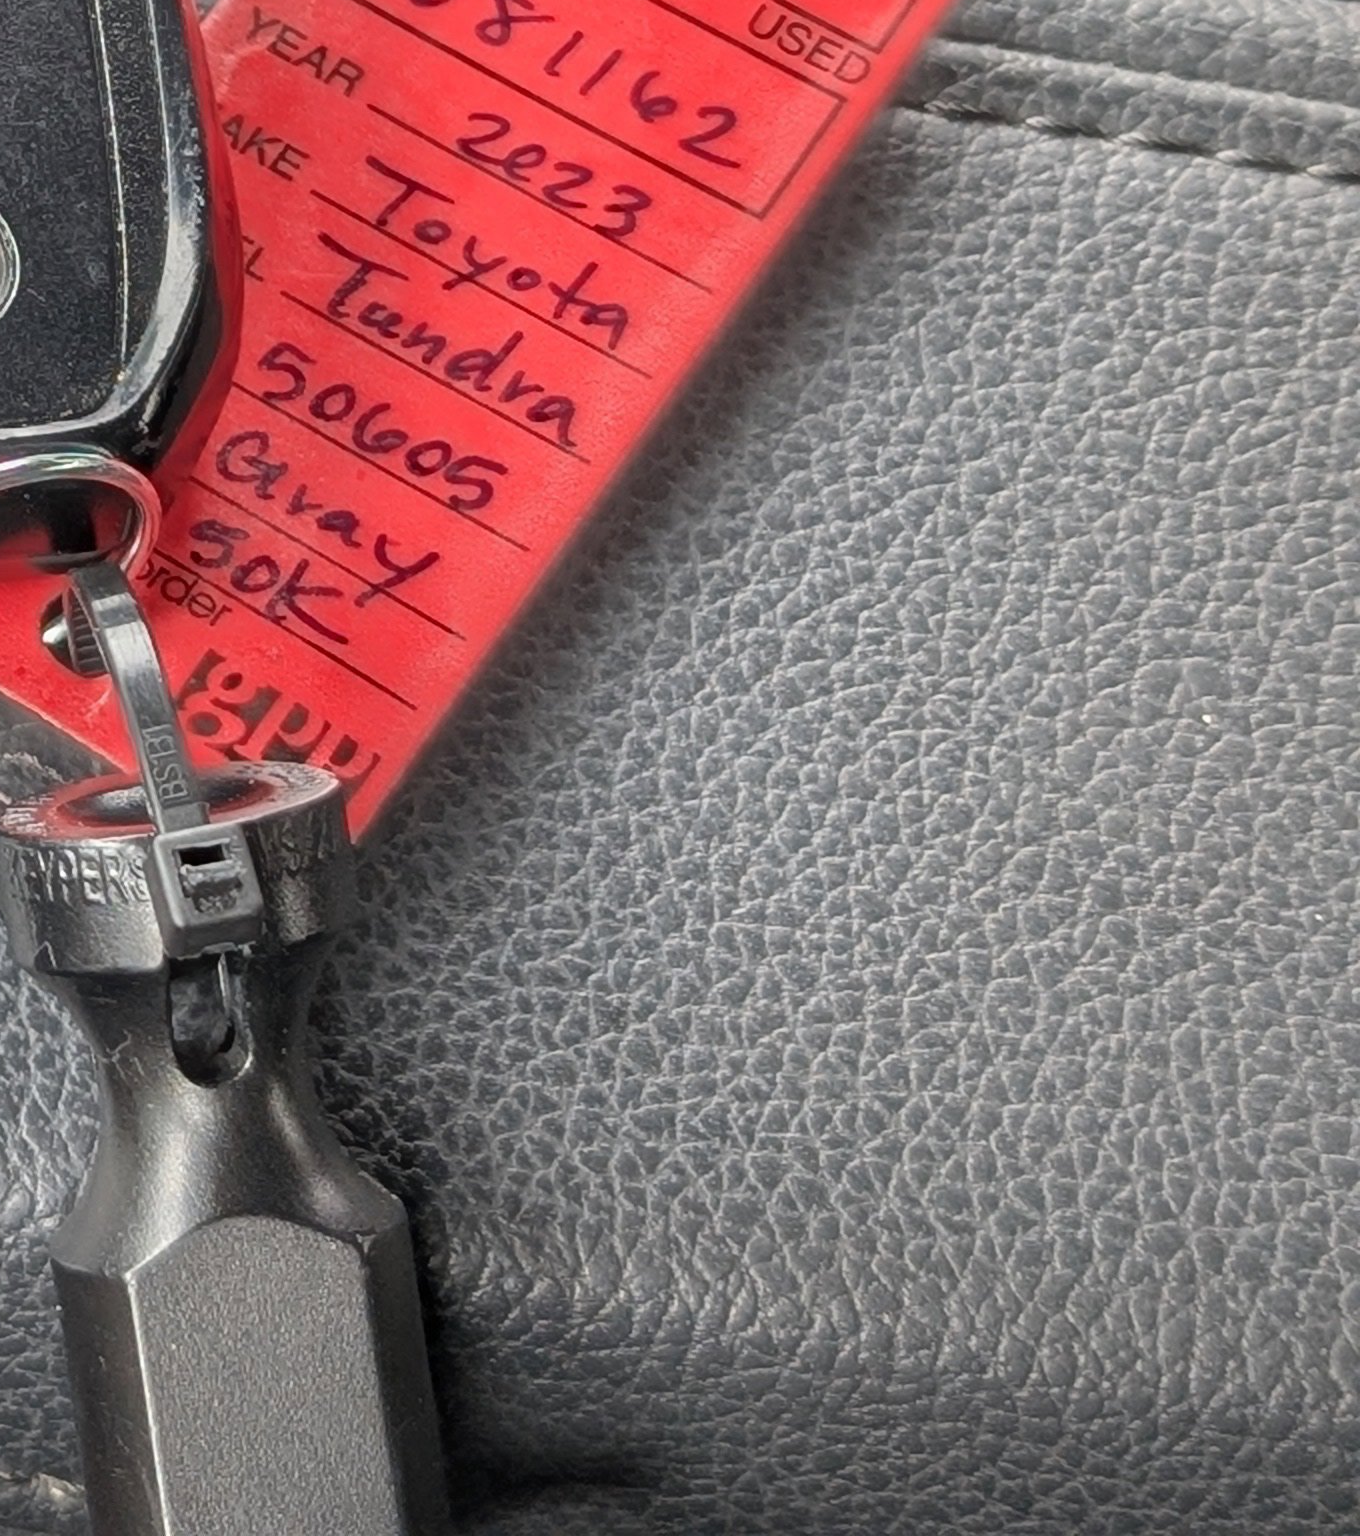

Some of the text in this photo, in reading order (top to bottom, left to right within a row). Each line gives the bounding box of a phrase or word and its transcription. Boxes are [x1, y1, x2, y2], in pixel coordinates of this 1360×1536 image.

[247, 6, 366, 97] YEAR
[746, 6, 873, 86] USED
[220, 113, 311, 182] AKE
[456, 112, 654, 240] 2023
[366, 155, 630, 351] Toyota
[317, 232, 578, 449] Tundra
[257, 341, 508, 511] 50605
[190, 519, 349, 645] 50K
[215, 430, 440, 607] Gray
